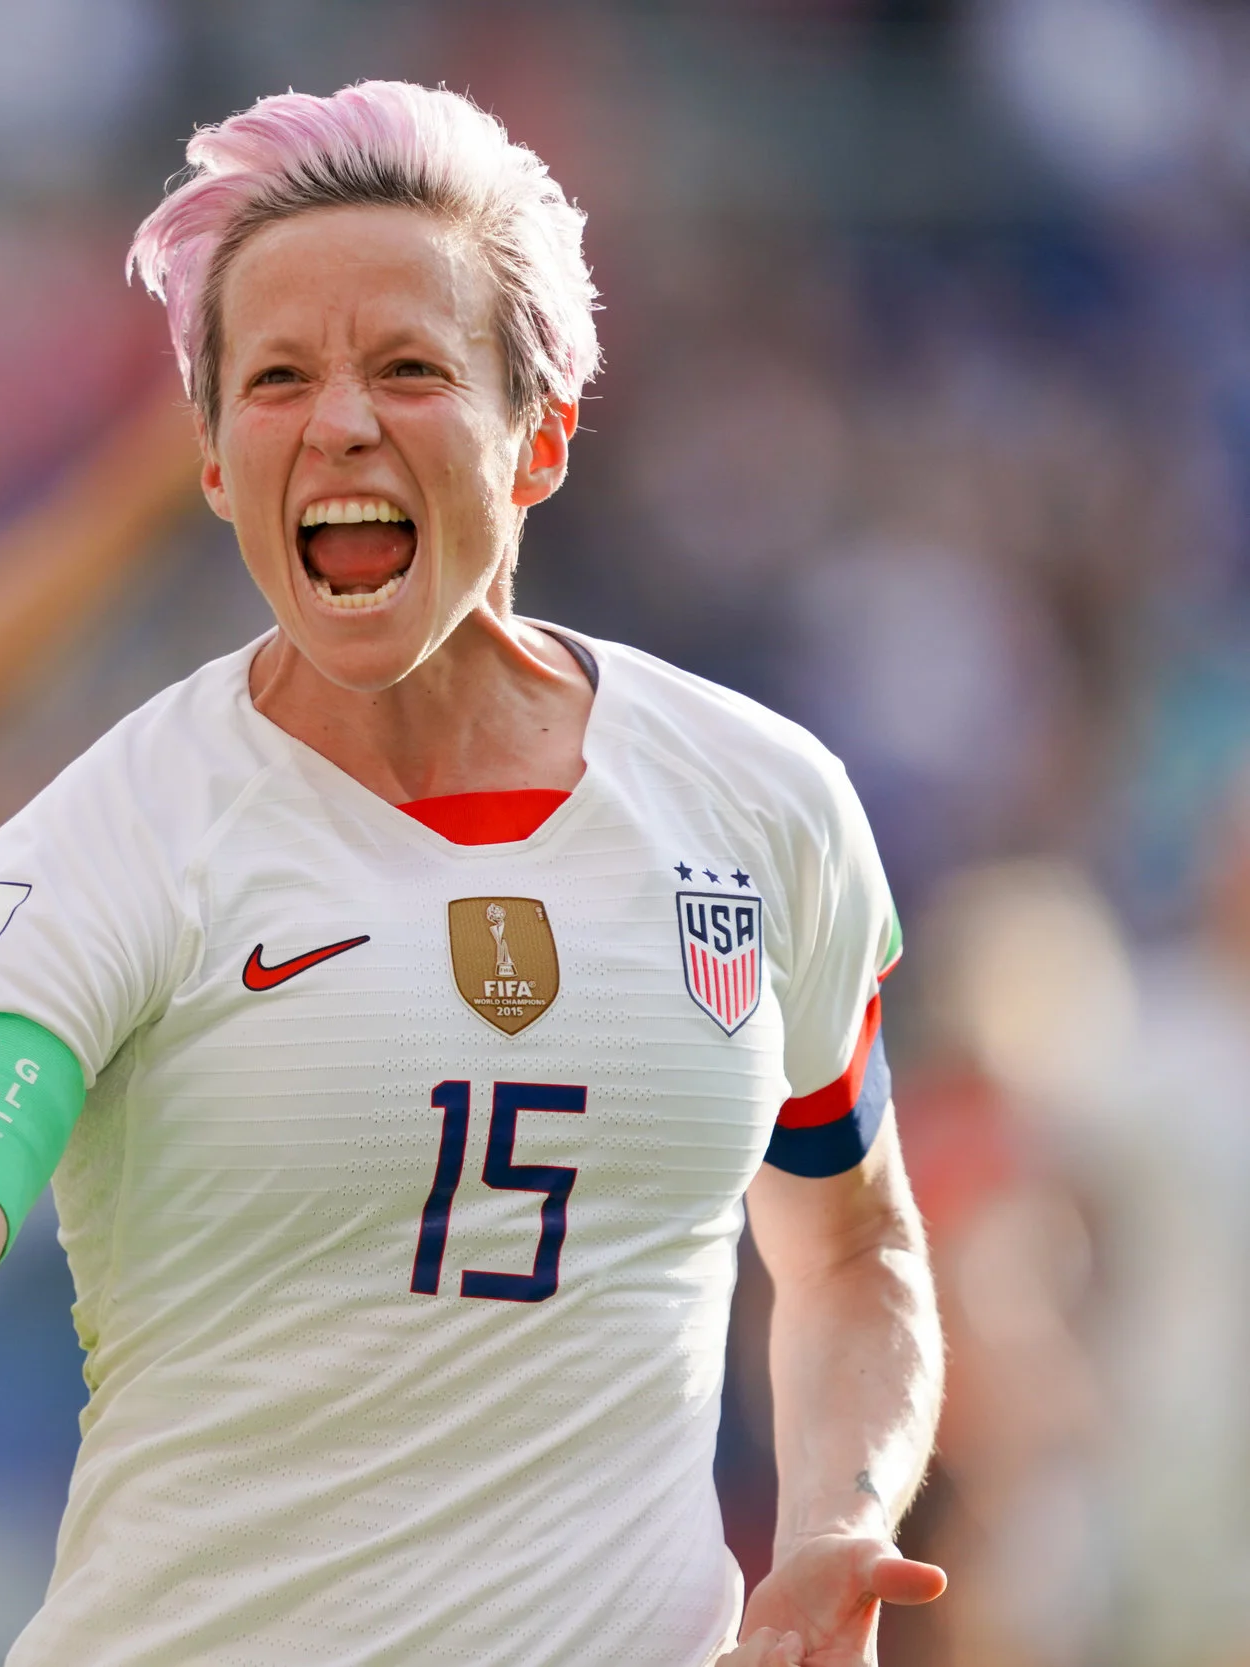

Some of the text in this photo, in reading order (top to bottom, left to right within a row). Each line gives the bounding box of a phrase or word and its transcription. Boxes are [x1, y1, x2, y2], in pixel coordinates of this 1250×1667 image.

[686, 902, 754, 955] USA
[496, 1006, 524, 1017] 2015
[501, 998, 546, 1006] CHAMPIONS
[410, 1080, 588, 1303] 15
